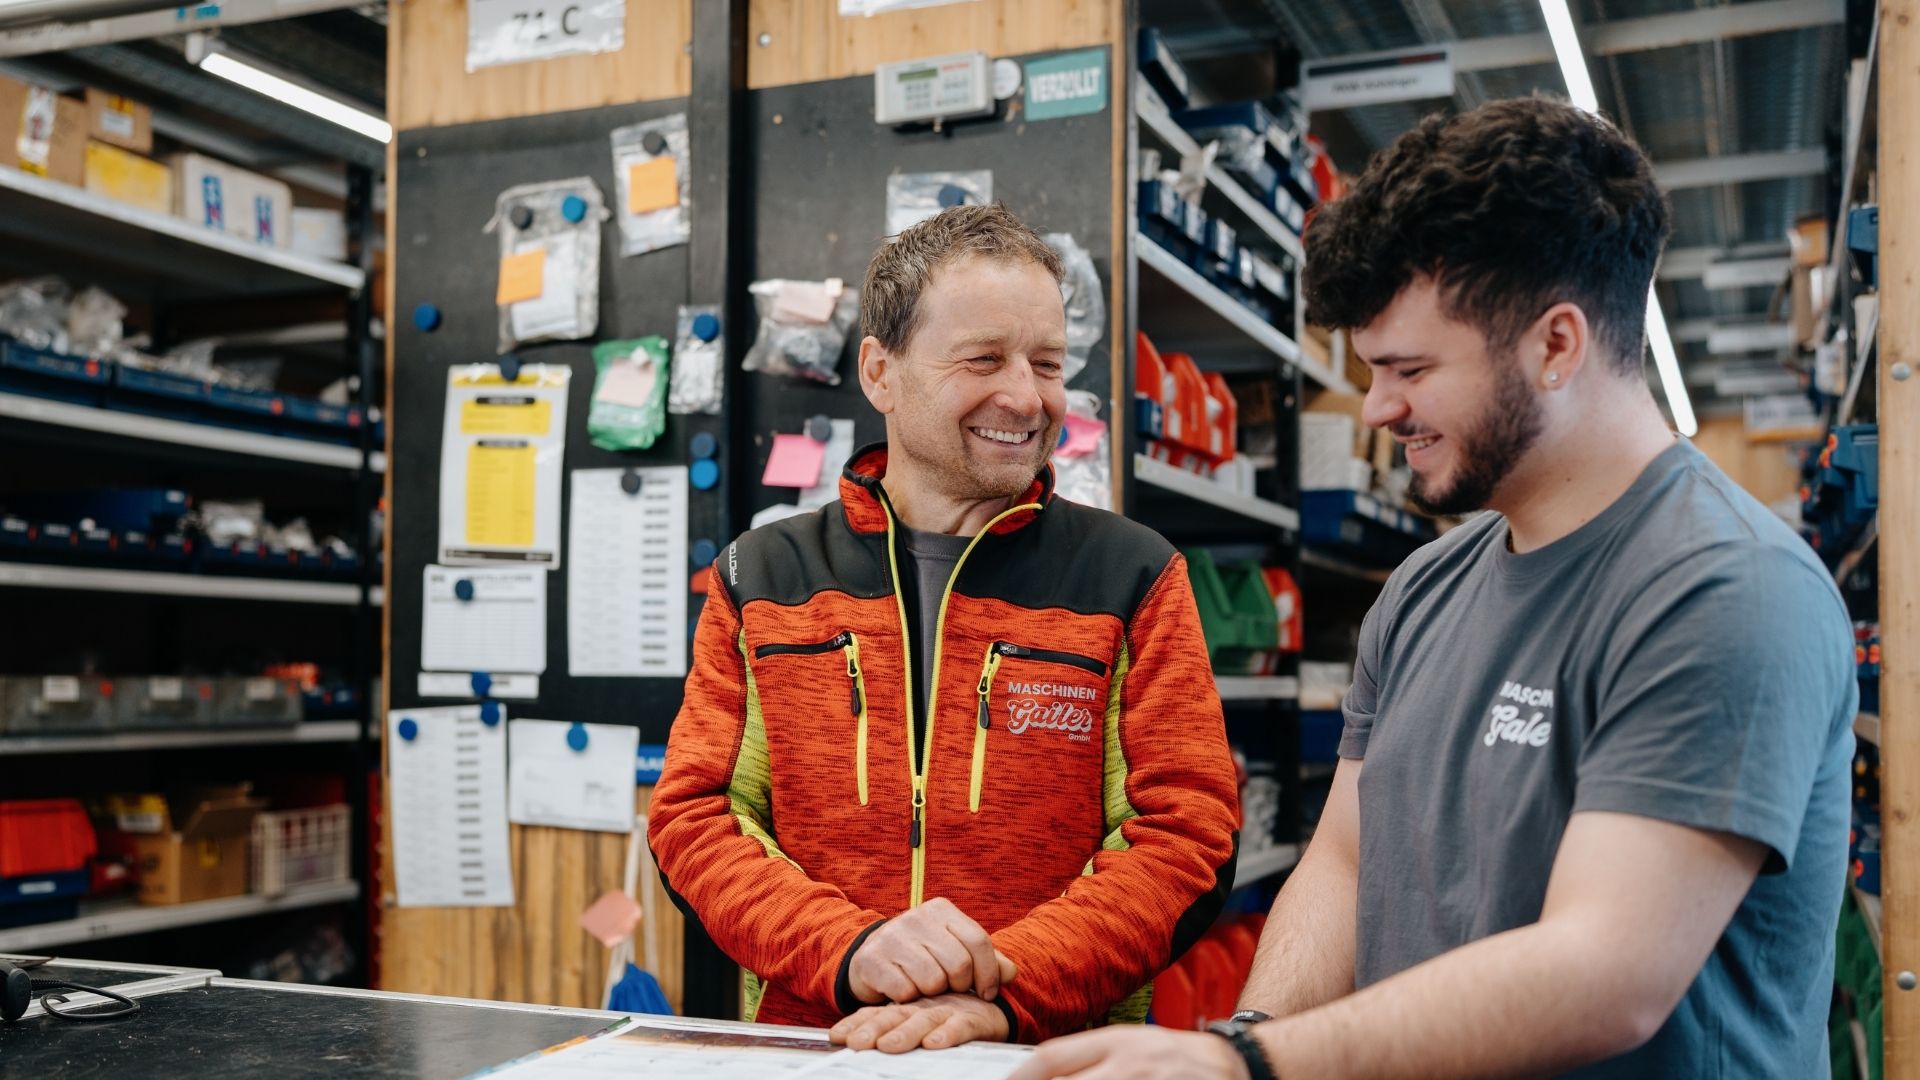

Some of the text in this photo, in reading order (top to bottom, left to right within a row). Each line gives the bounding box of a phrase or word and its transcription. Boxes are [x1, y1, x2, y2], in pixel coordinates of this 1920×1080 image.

[561, 5, 580, 36] C
[1029, 66, 1101, 104] VERZOLLT
[1007, 681, 1096, 700] MASCHINEN
[1007, 698, 1093, 734] Gailer
[1068, 733, 1091, 742] GmbH
